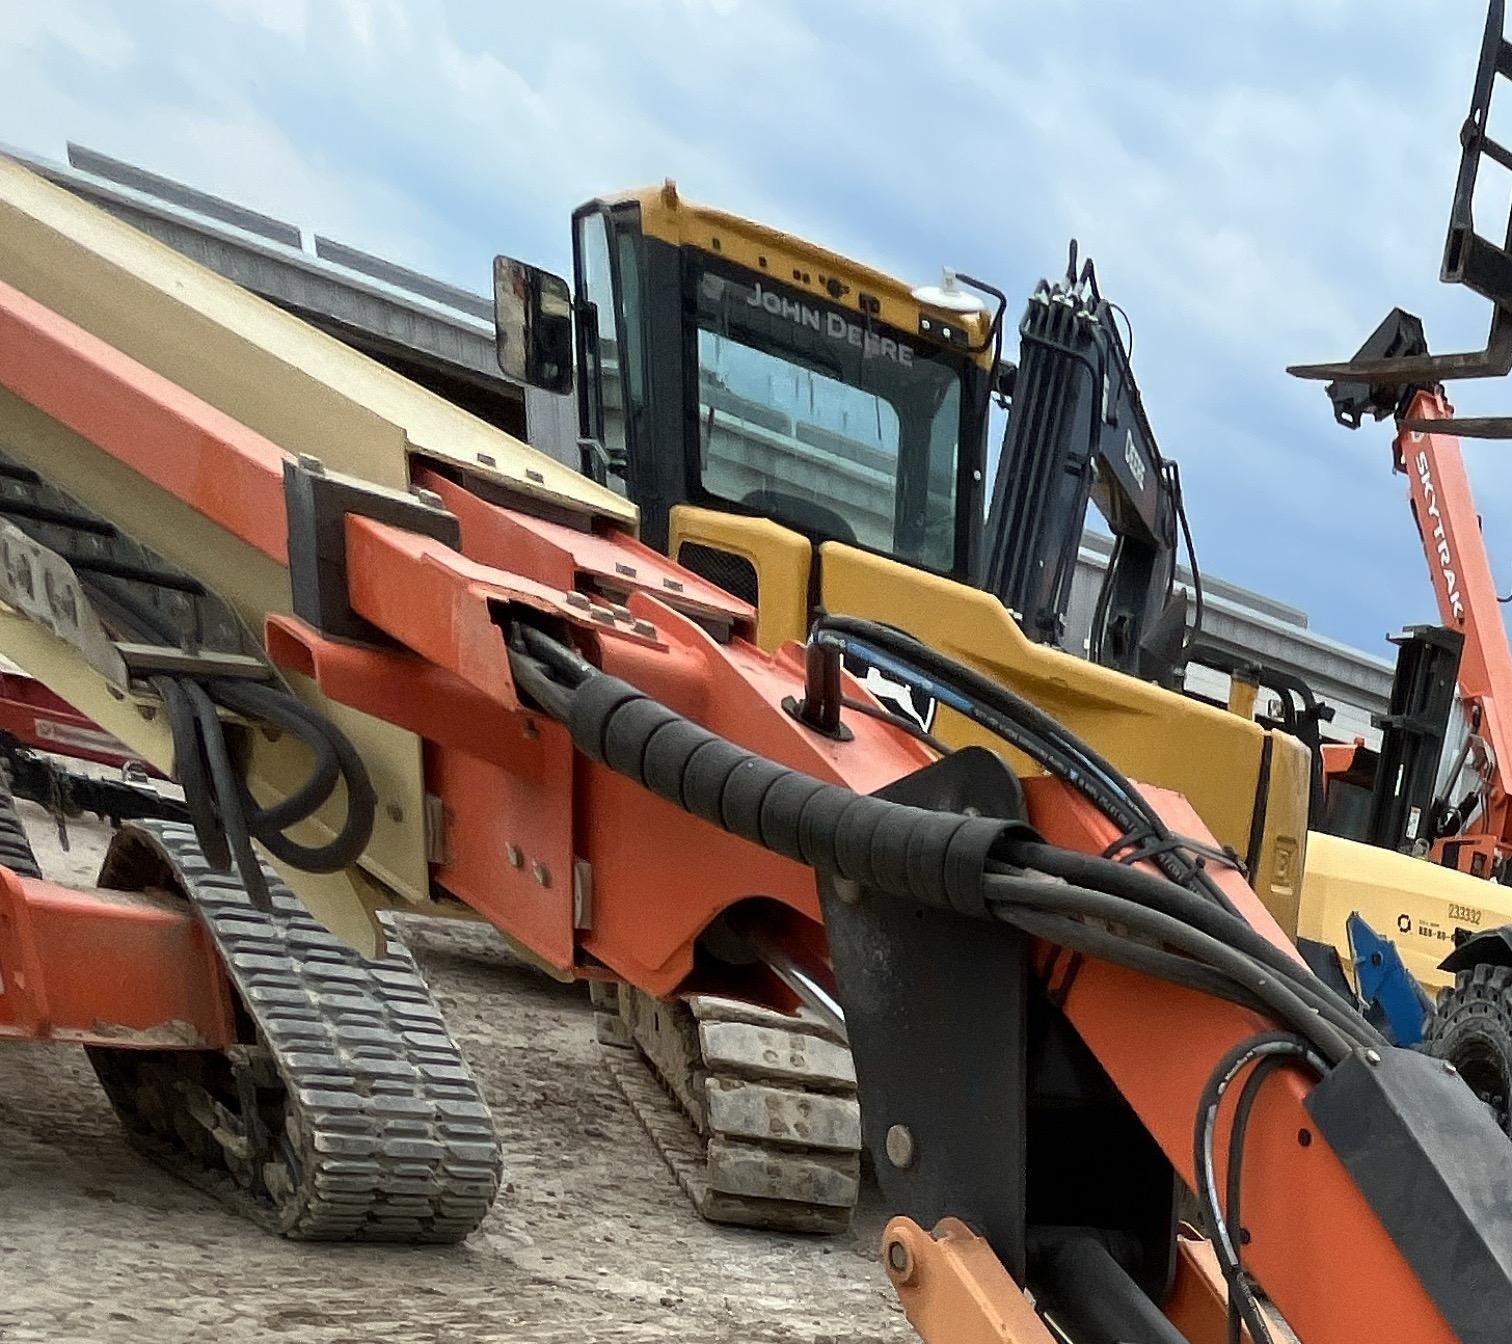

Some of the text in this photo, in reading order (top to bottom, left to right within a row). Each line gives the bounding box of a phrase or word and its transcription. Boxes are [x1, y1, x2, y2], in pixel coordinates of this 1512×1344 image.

[746, 282, 915, 368] JOHN DEERE
[1415, 451, 1465, 620] SKYTRAK
[1448, 902, 1483, 926] 233332
